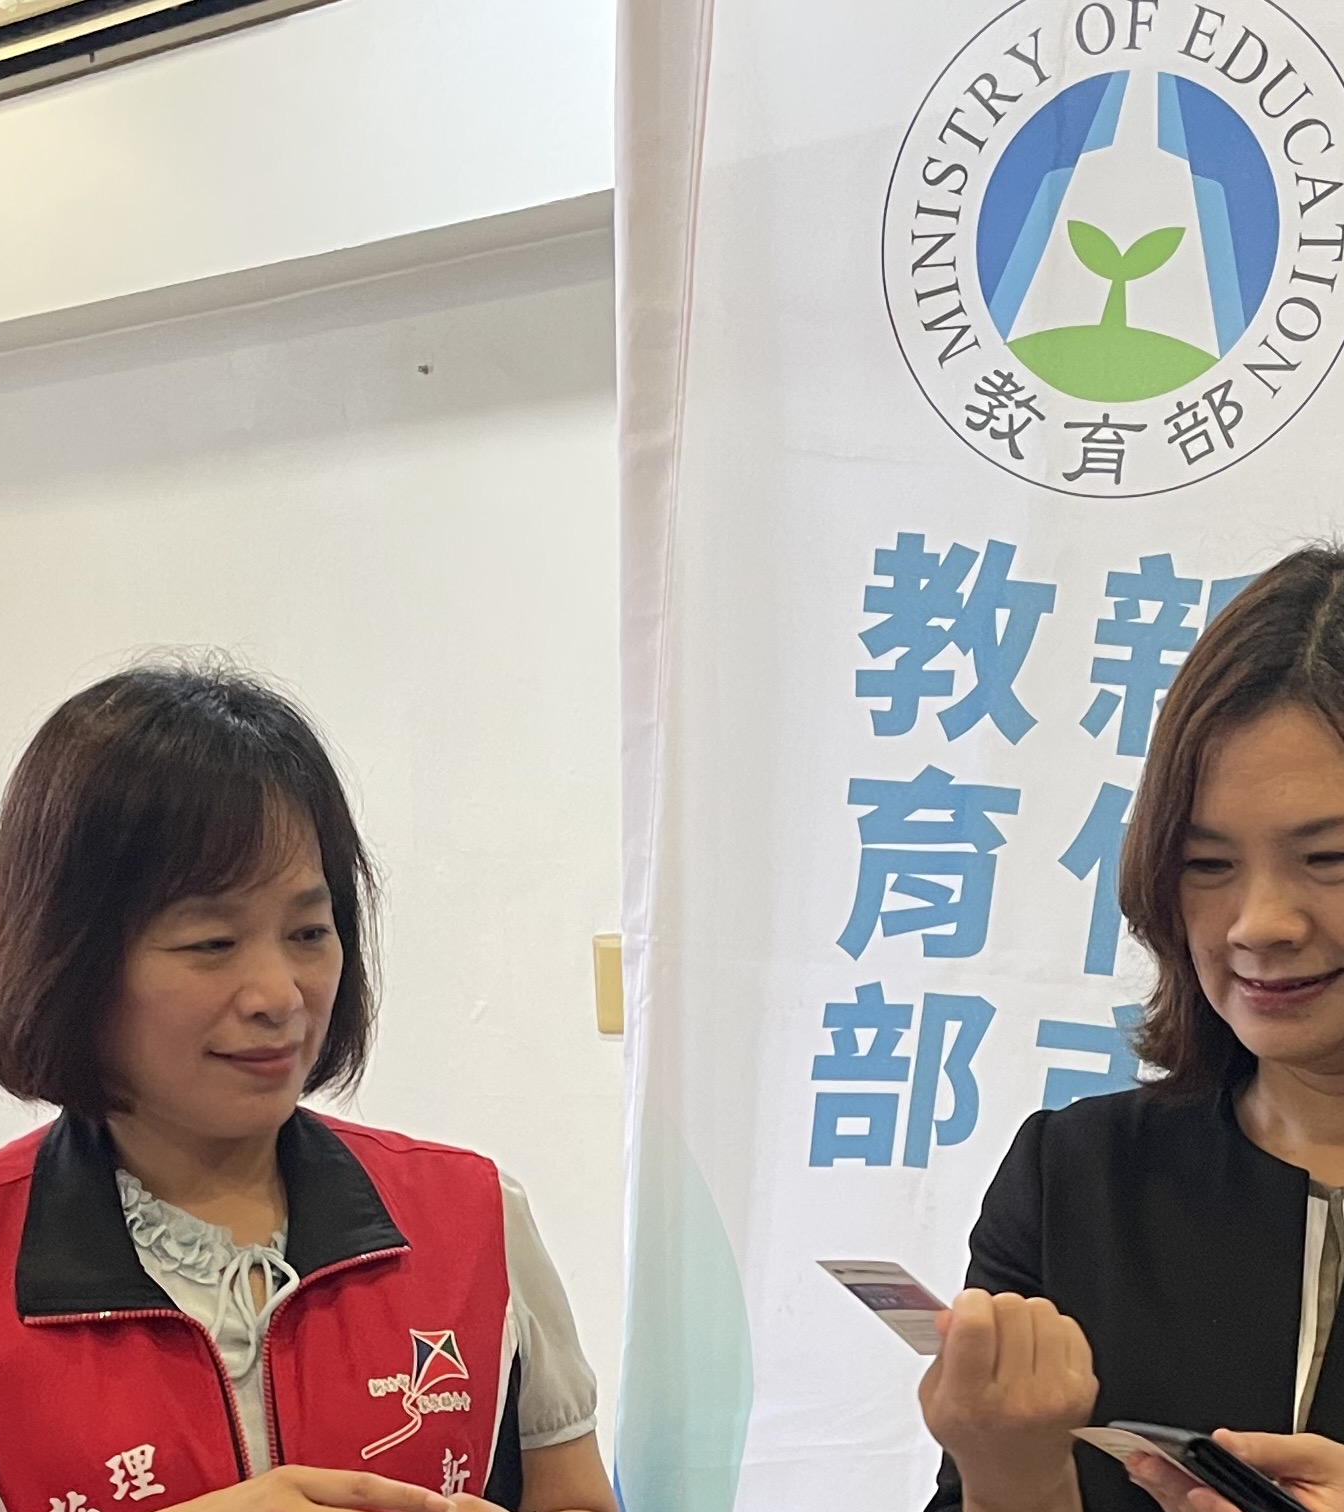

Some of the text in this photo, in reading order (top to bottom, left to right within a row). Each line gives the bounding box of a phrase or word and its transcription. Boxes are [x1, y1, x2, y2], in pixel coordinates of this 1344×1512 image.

[911, 27, 1052, 368] MINISTRY
[1074, 0, 1160, 57] OF
[964, 369, 1244, 486] 教育部
[808, 531, 1058, 1170] 教育部
